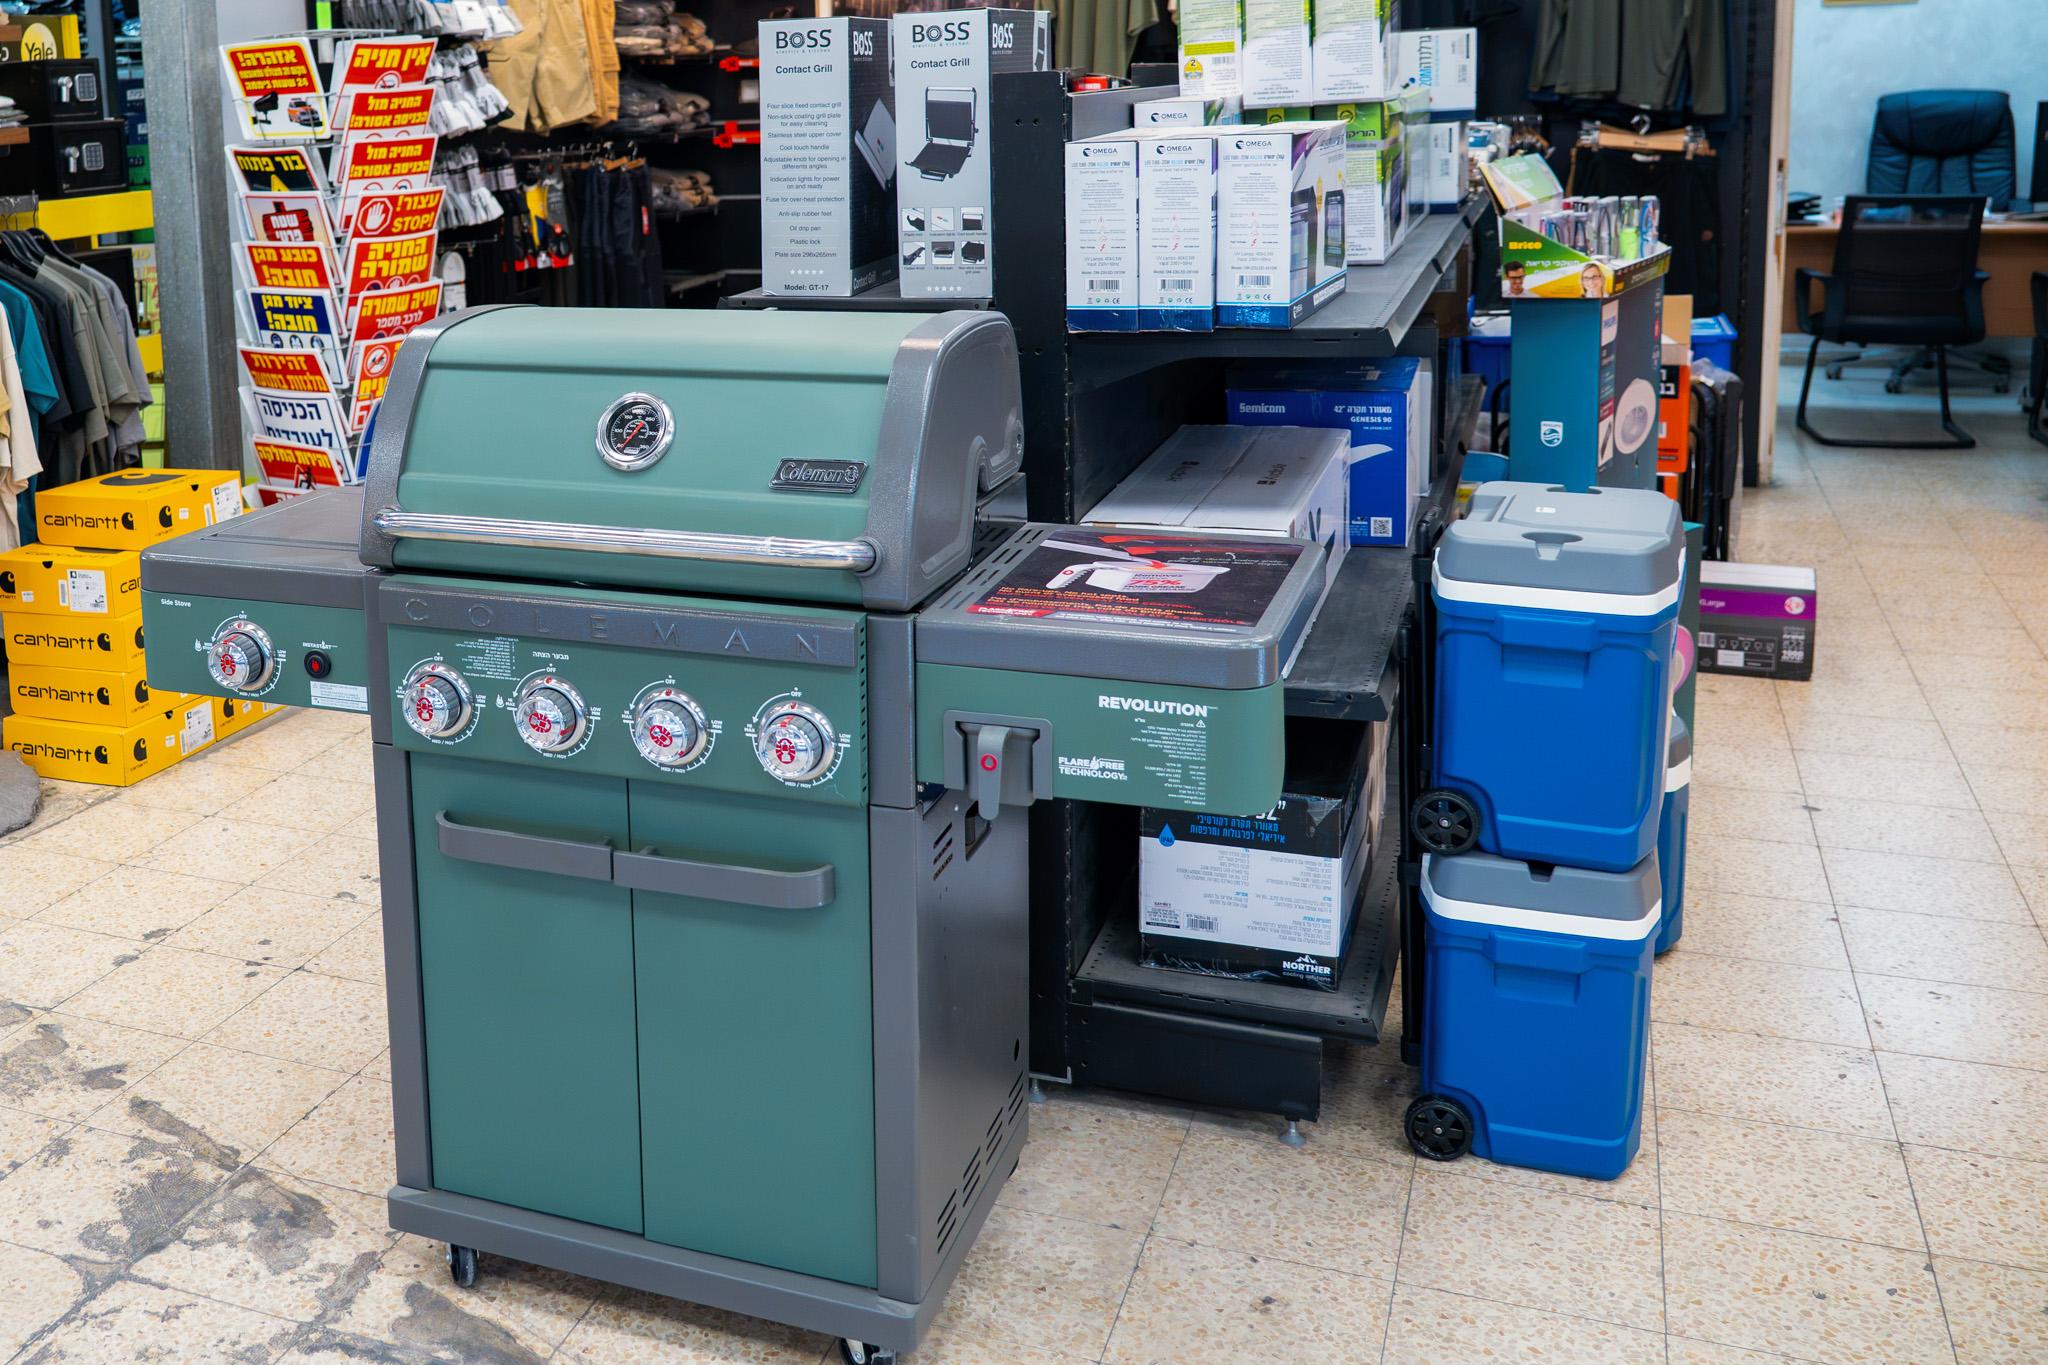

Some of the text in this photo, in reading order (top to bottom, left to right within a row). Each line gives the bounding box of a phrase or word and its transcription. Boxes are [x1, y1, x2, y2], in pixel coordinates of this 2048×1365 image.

[776, 29, 832, 49] BOSS
[912, 22, 970, 43] BOSS
[992, 23, 1014, 48] BOSS
[25, 42, 54, 60] Yale
[853, 31, 873, 56] BOSS
[236, 49, 298, 67] אזהרה!
[353, 46, 431, 71] אין חניה
[911, 58, 970, 69] Contact Grill
[776, 64, 833, 74] Contact Grill
[296, 78, 308, 87] 24
[368, 96, 422, 110] החניה מול
[350, 111, 430, 128] הכניסה אסורה!
[1161, 112, 1188, 120] OMEGA
[367, 144, 422, 160] החניה מול
[236, 154, 306, 172] בור פתוח
[350, 160, 430, 178] הכניסה אסורה!
[396, 192, 441, 212] עצור!
[270, 214, 299, 228] שטח
[392, 212, 435, 233] STOP!
[252, 248, 318, 264] כובע מגן
[368, 238, 428, 260] החניה
[360, 253, 428, 278] שמורה
[262, 265, 319, 288] חובה!
[261, 294, 314, 310] ציוד מגן
[361, 288, 439, 316] חניה שמורה
[265, 310, 318, 332] חובה!
[376, 310, 424, 328] לרכב מספר
[250, 354, 308, 371] זהירות
[261, 399, 322, 420] הכניסה
[1240, 402, 1286, 414] Semicom
[780, 462, 844, 482] Coleman
[44, 513, 120, 530] carhartt
[160, 598, 192, 608] Side Stove
[406, 598, 820, 660] COLEMAN
[14, 632, 94, 650] carhartt
[18, 684, 94, 704] carhartt
[1098, 696, 1208, 717] REVOLUTION
[12, 742, 92, 763] carhartt
[1058, 756, 1125, 770] FLARE FREE
[1059, 766, 1123, 780] TECHNOLOGY
[1231, 818, 1251, 830] תקרה
[1258, 832, 1286, 844] אידיאלי
[1282, 960, 1332, 975] NORTHER
[1282, 971, 1304, 980] cooling
